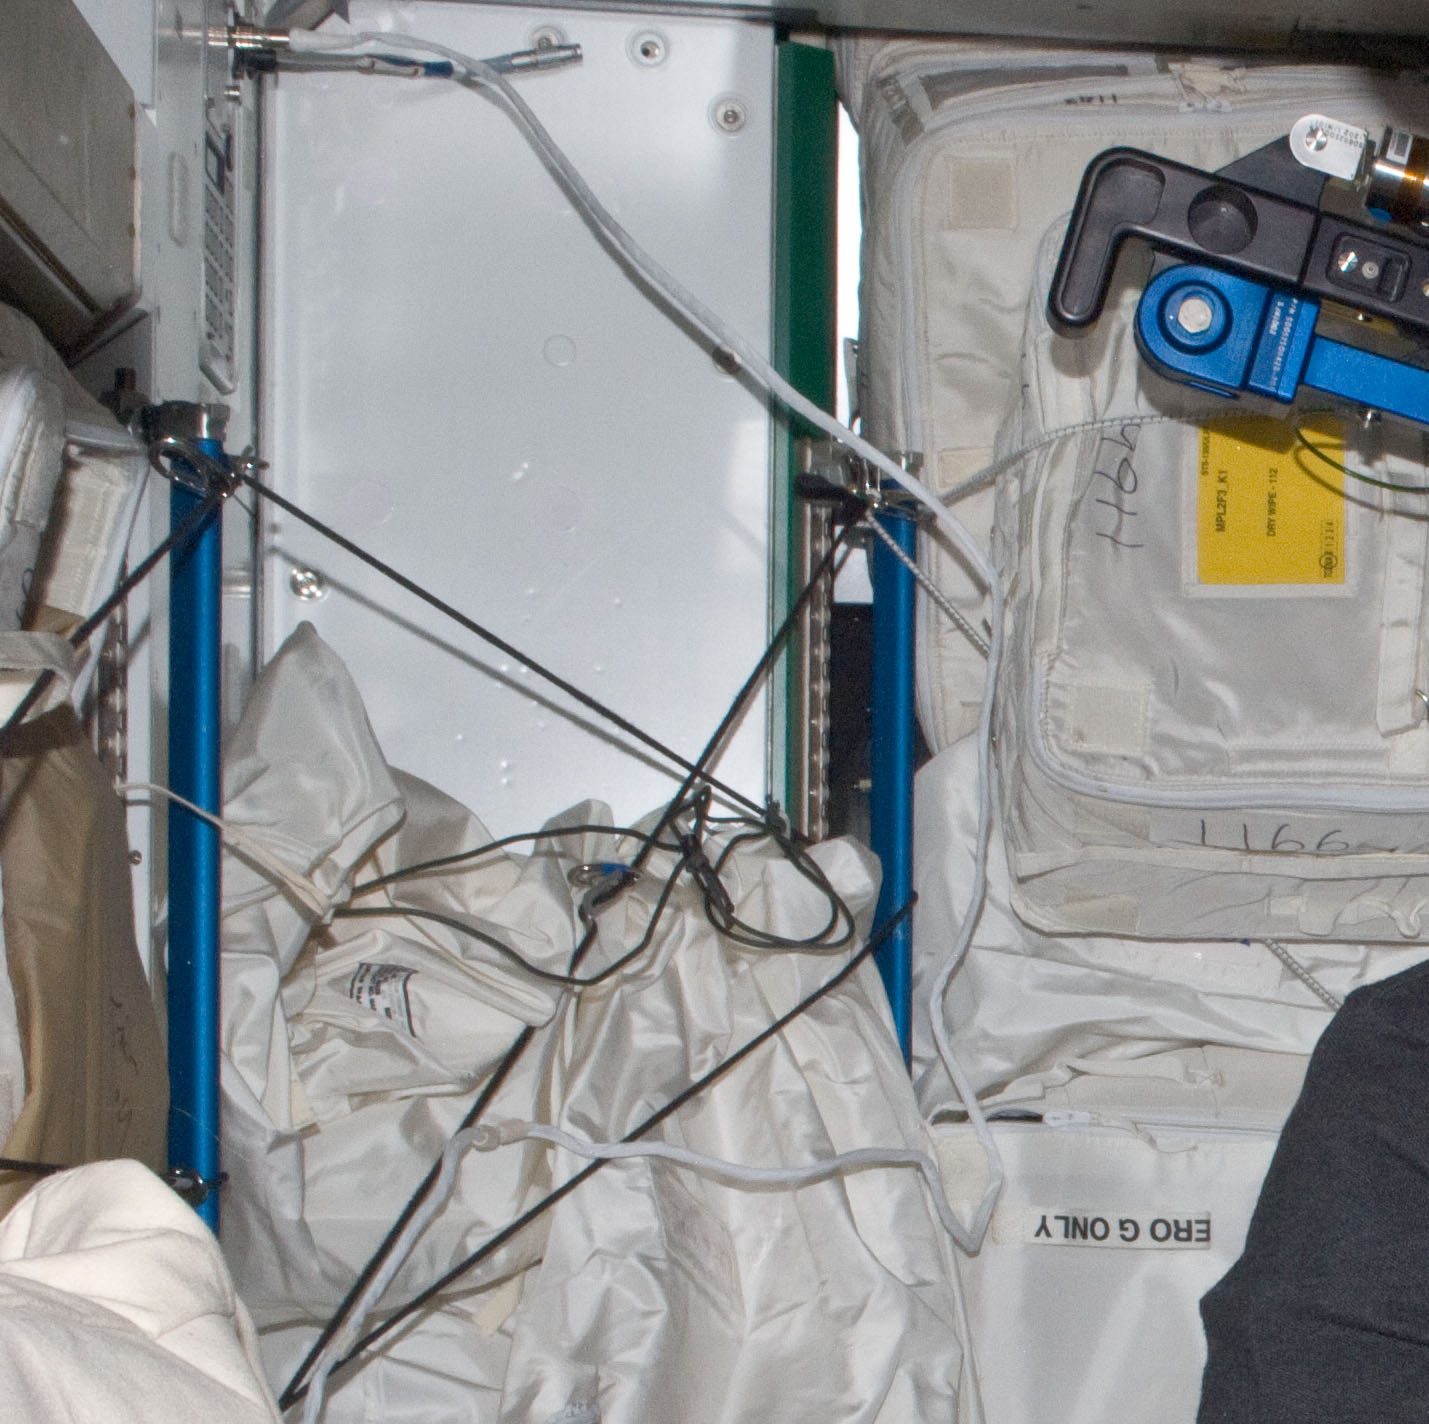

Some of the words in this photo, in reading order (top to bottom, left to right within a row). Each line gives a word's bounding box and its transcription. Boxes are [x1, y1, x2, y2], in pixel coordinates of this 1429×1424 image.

[1267, 492, 1277, 515] WIPE
[1266, 518, 1276, 537] DRY
[1034, 1215, 1111, 1242] ONLY
[1119, 1218, 1140, 1242] G
